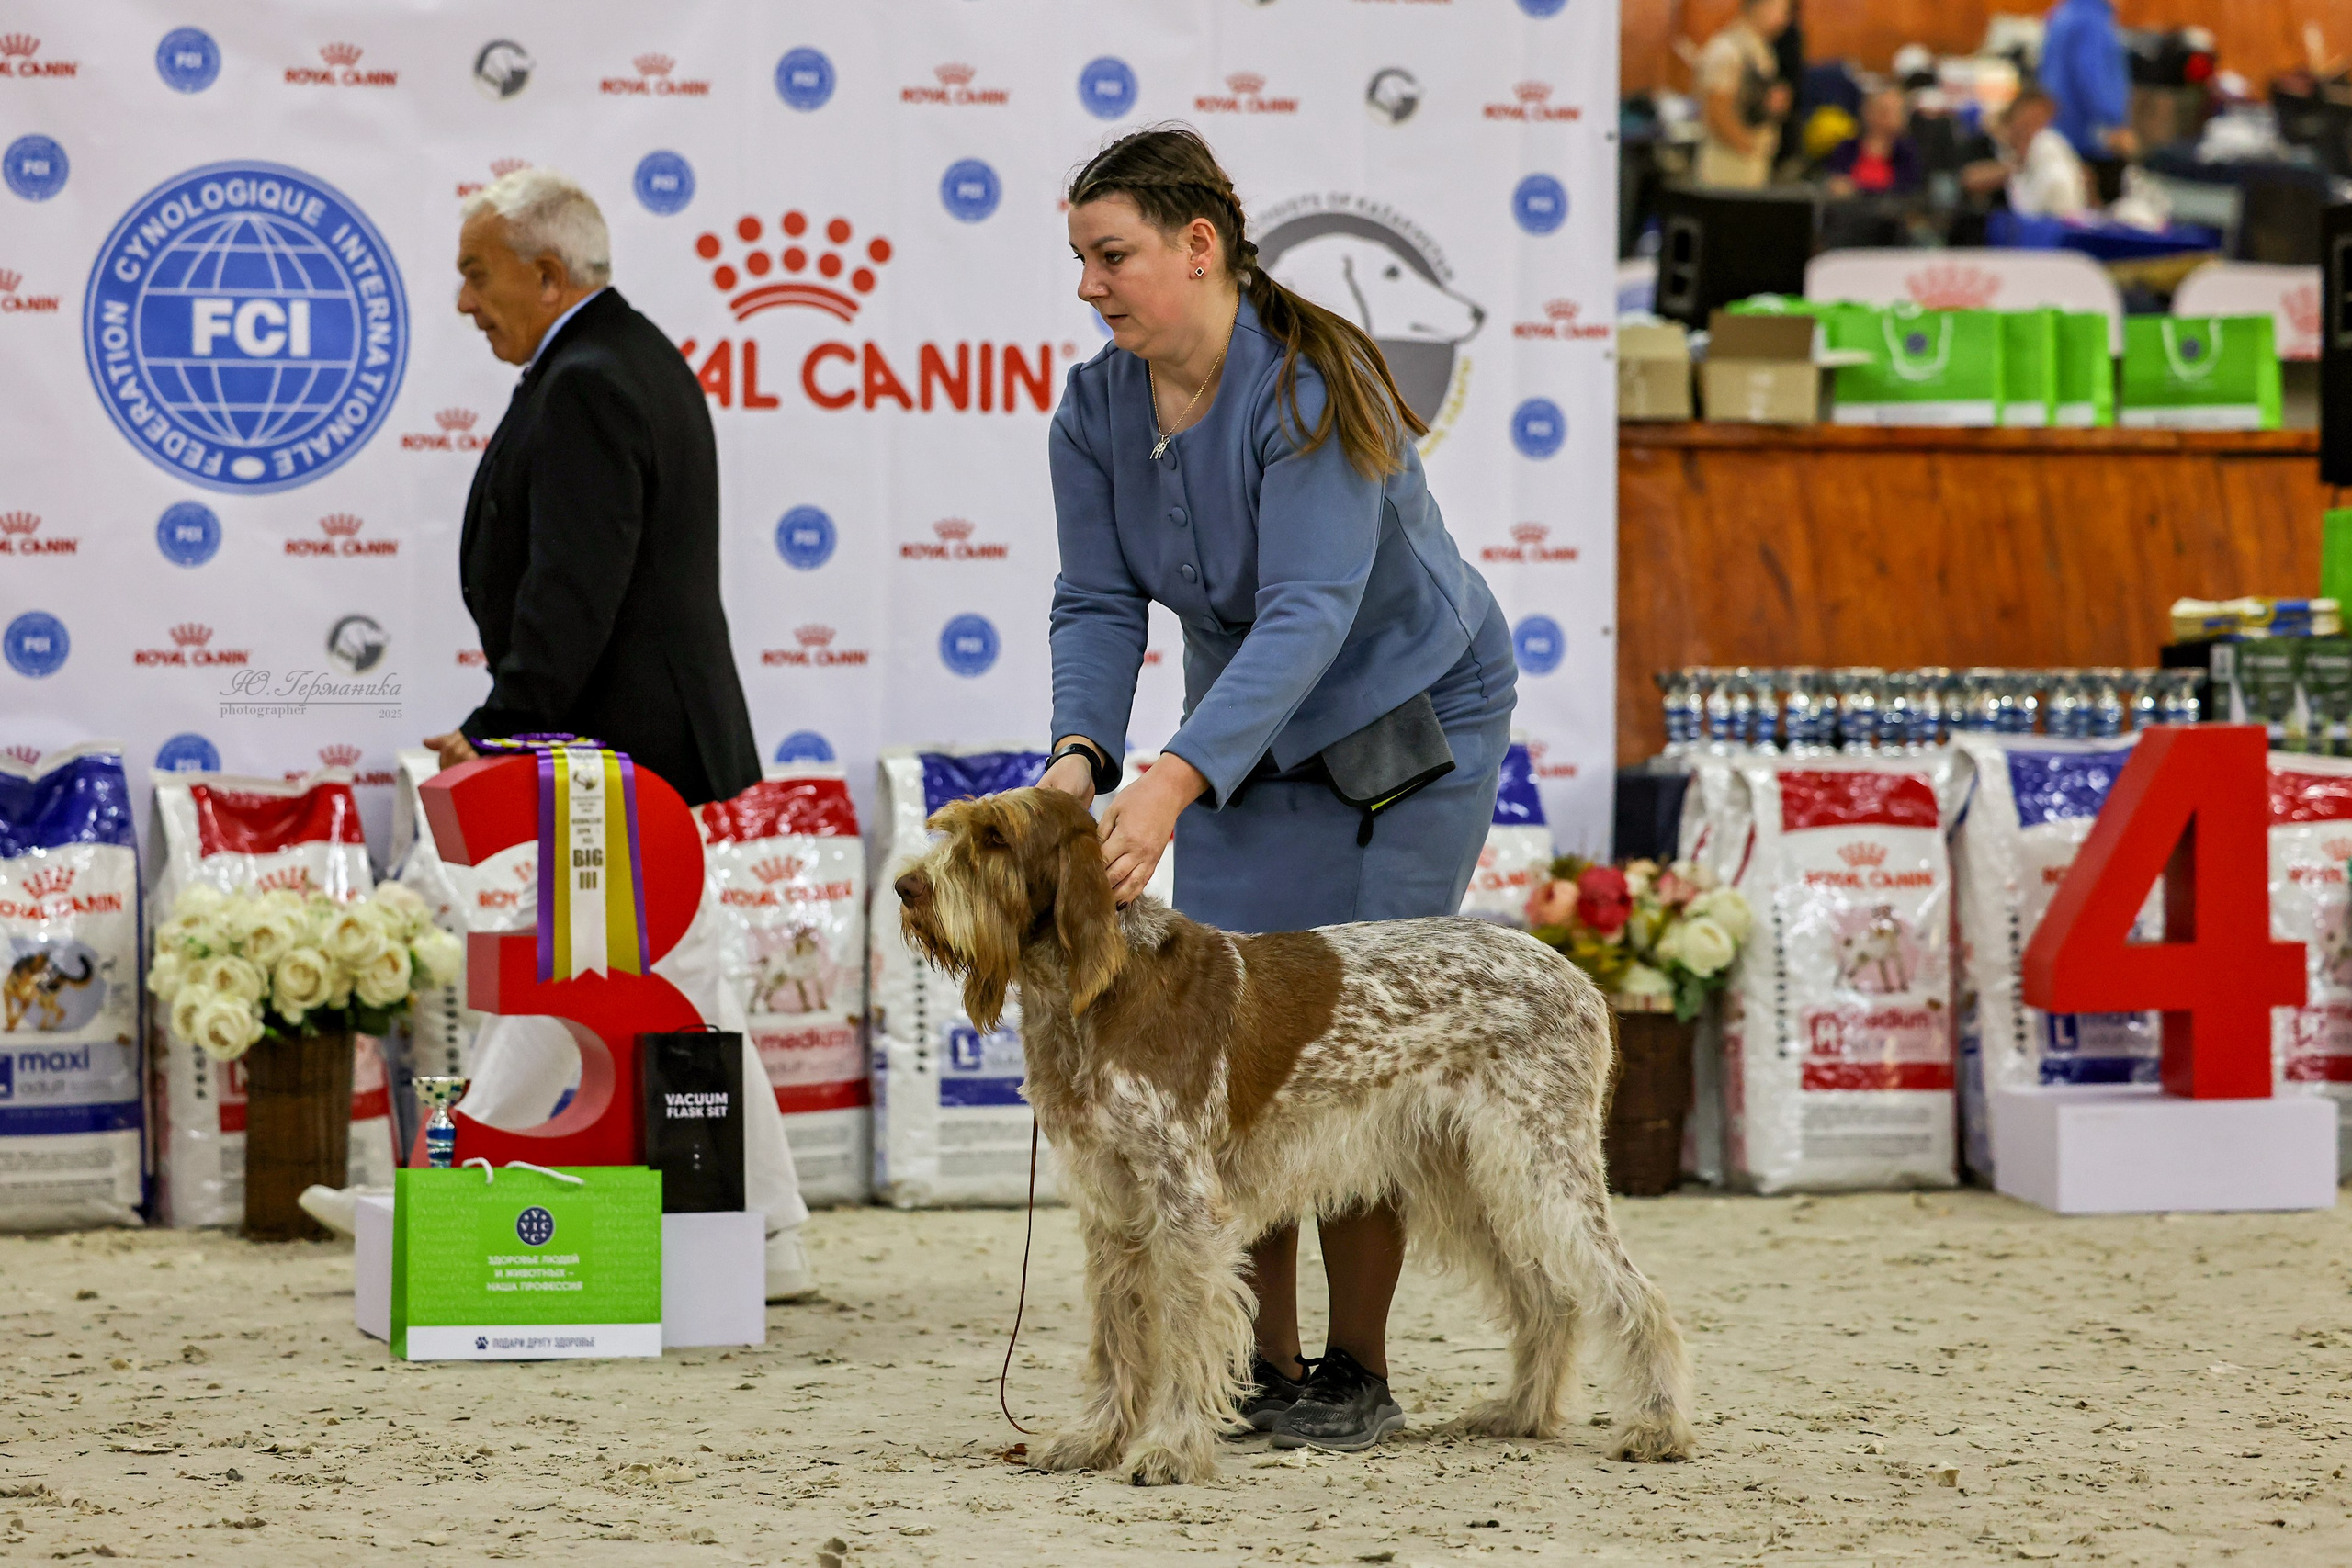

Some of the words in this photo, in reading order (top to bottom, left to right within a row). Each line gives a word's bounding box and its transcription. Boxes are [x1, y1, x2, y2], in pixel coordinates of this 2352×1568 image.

[114, 178, 327, 282] CYNOLOGIQUE
[192, 299, 311, 358] FCI
[272, 223, 392, 477] INTERNATIONALE
[800, 340, 1055, 412] CANIN
[101, 299, 226, 477] FEDERATION
[352, 771, 396, 786] ANIN
[573, 849, 603, 868] BIG
[579, 871, 597, 889] III
[2023, 724, 2307, 1100] 4
[18, 1043, 90, 1073] maxi
[665, 1092, 729, 1106] VACUUM
[666, 1106, 705, 1119] FLASK
[706, 1106, 728, 1118] SET
[487, 1255, 539, 1266] ЗДОРОВЬЕ
[542, 1253, 580, 1265] ЛЮДЕЙ
[494, 1269, 503, 1278] И
[505, 1269, 566, 1278] ЖИВОТНЫХ
[486, 1282, 518, 1292] НАША
[520, 1280, 583, 1292] ПРОФЕССИЯ
[492, 1337, 525, 1348] ПОДАРИ
[526, 1337, 551, 1348] ДРУГУ
[554, 1337, 595, 1348] ЗДОРОВЬЕ
